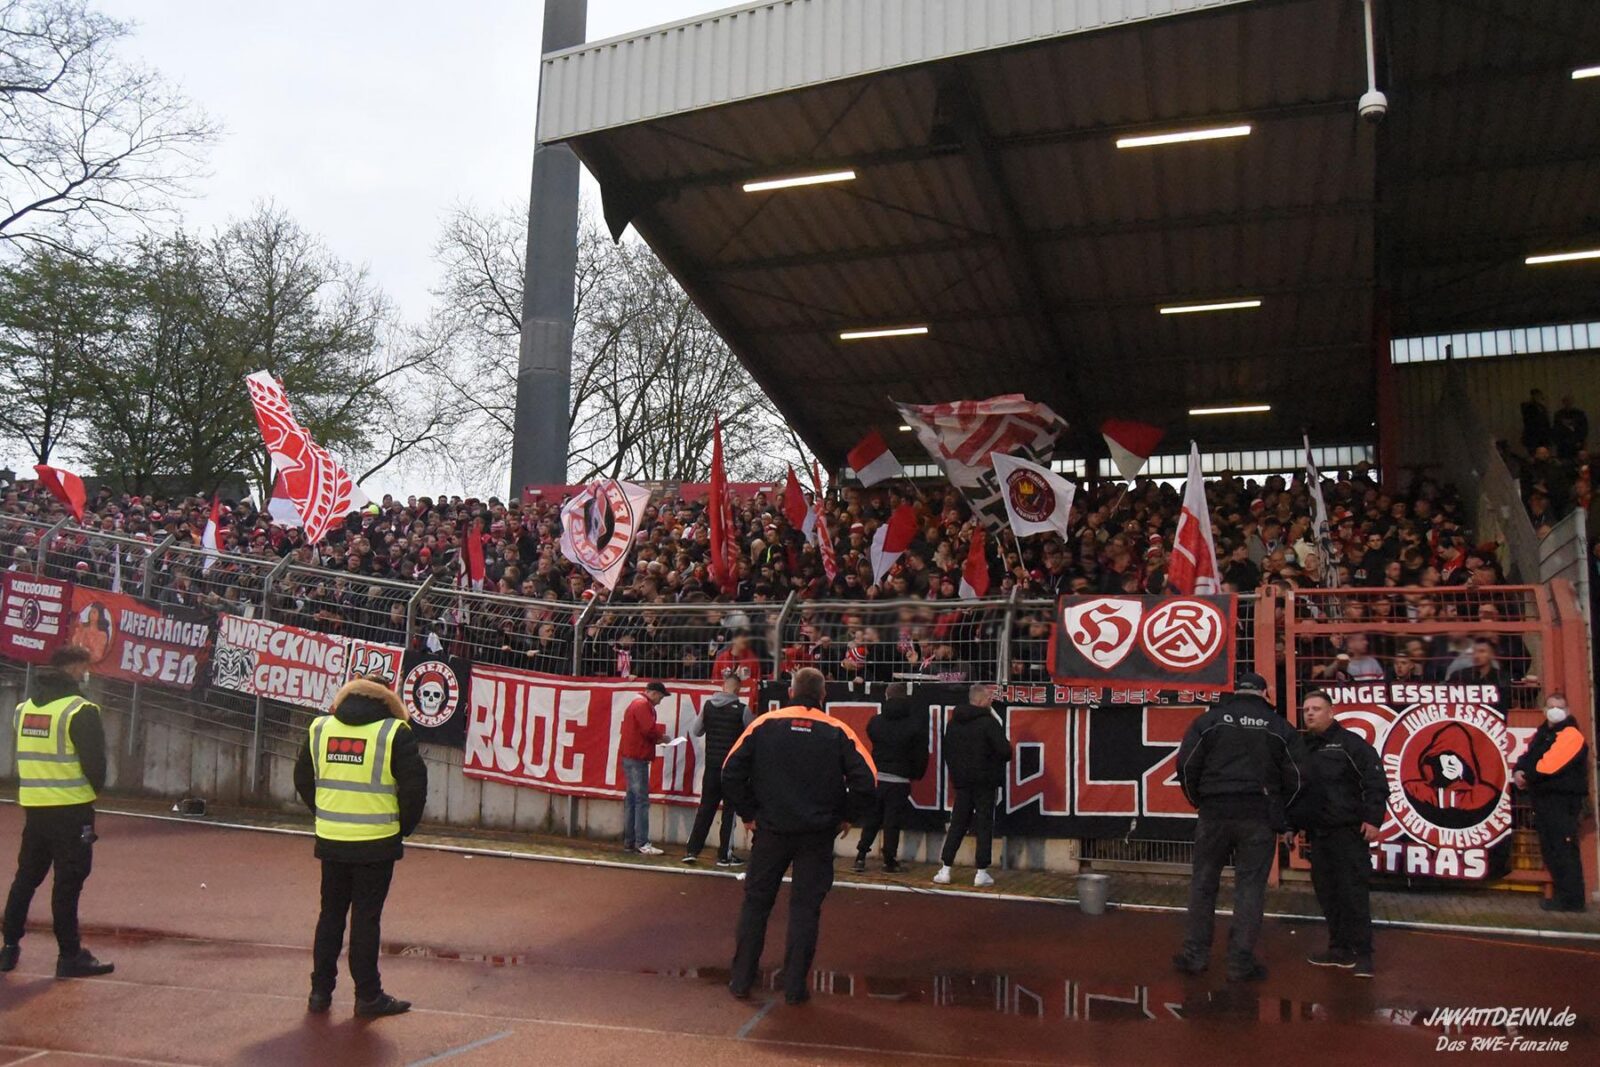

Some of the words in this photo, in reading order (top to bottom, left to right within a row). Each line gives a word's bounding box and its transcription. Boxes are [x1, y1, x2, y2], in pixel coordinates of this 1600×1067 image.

[228, 617, 345, 675] WRECKING
[120, 640, 198, 684] ESSEN
[352, 648, 395, 682] LPL
[408, 663, 456, 687] FREAKS
[254, 664, 328, 701] CREW
[1391, 684, 1498, 704] ESSENER
[407, 702, 452, 725] ULTRAS
[465, 676, 591, 784] RUDE
[327, 753, 363, 763] SECURITAS
[1438, 821, 1492, 848] WEISS
